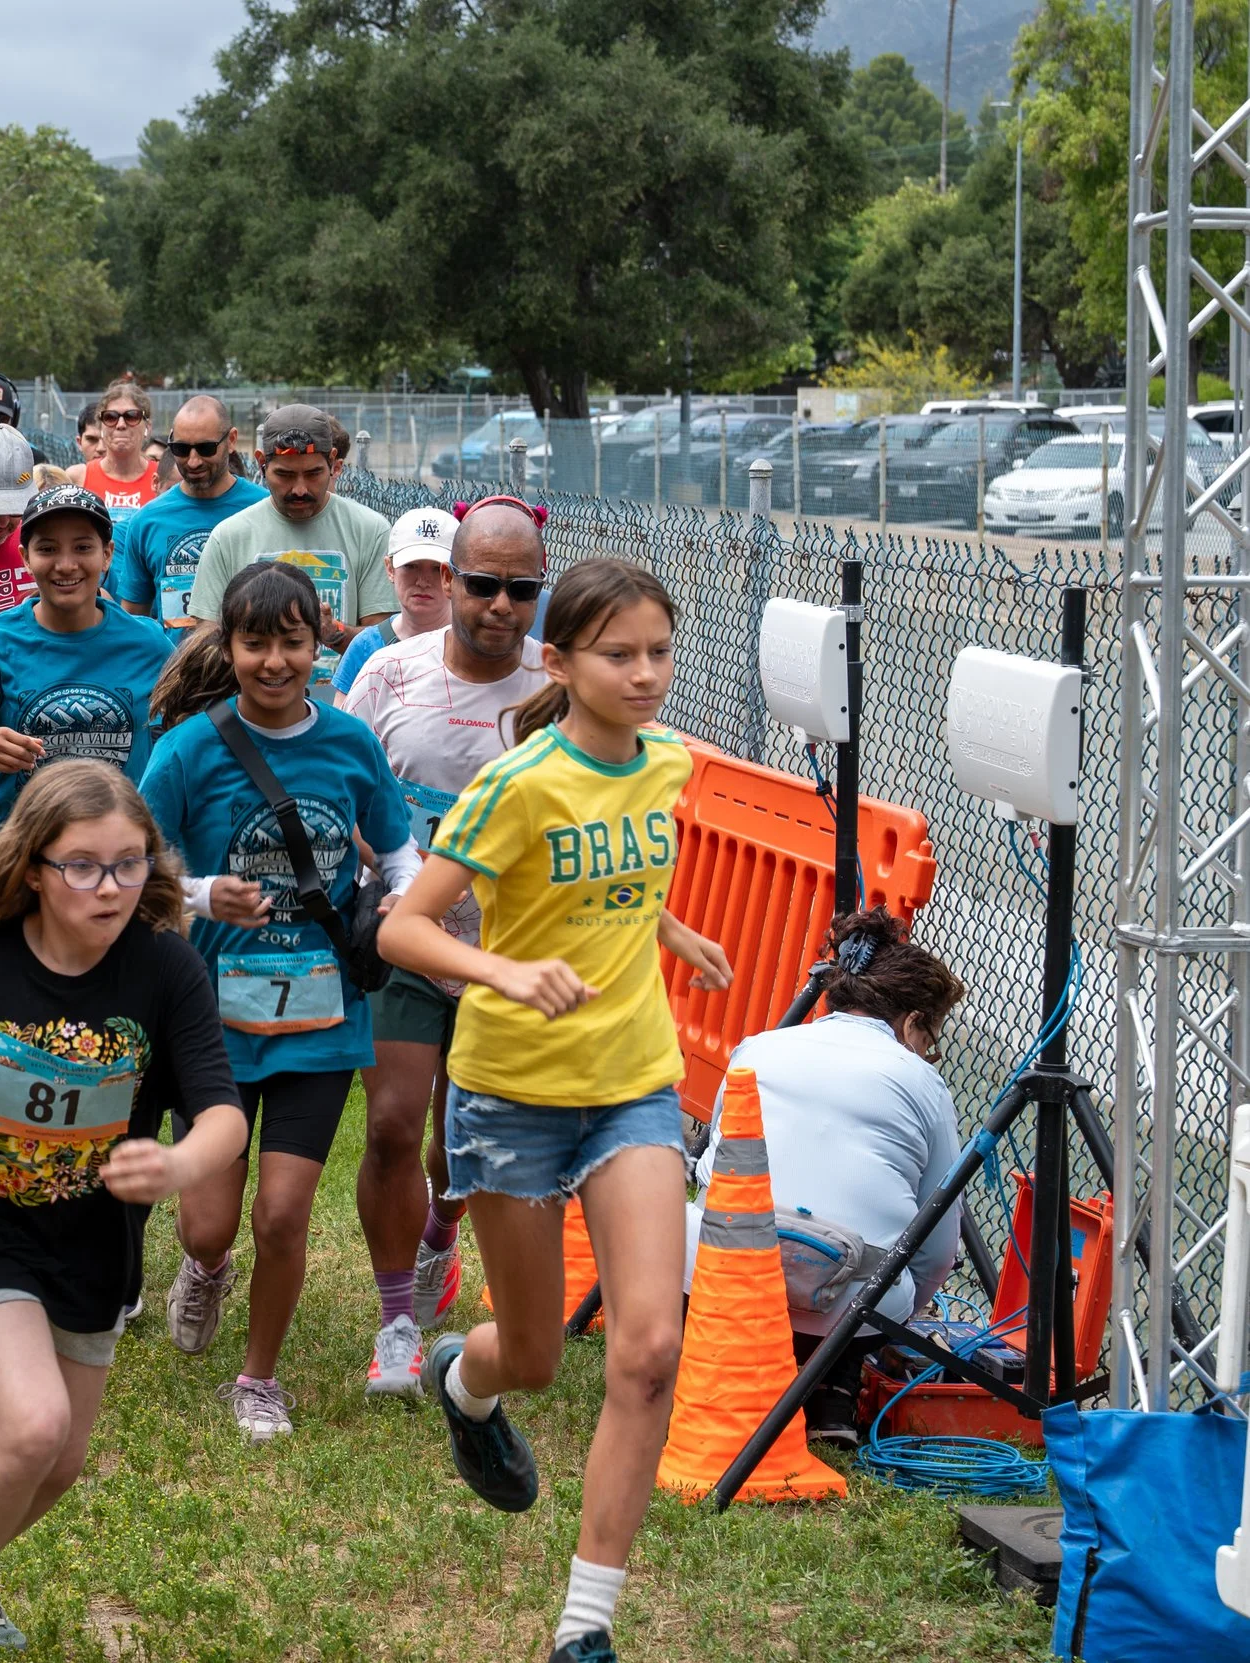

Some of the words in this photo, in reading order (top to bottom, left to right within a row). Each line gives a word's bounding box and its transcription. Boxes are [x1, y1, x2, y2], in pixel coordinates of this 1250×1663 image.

[36, 496, 96, 513] EAGLES
[105, 490, 141, 508] NIKE
[169, 564, 198, 575] CRESCE
[448, 718, 496, 729] SALOMON
[45, 732, 84, 746] SCENTA
[88, 732, 130, 745] VALLEY
[46, 746, 120, 758] OMETOWN
[274, 911, 293, 923] 5K
[565, 915, 613, 927] SOUTH
[258, 929, 301, 949] 2026
[270, 979, 292, 1018] 7
[53, 1076, 68, 1085] 5K
[25, 1081, 81, 1126] 81
